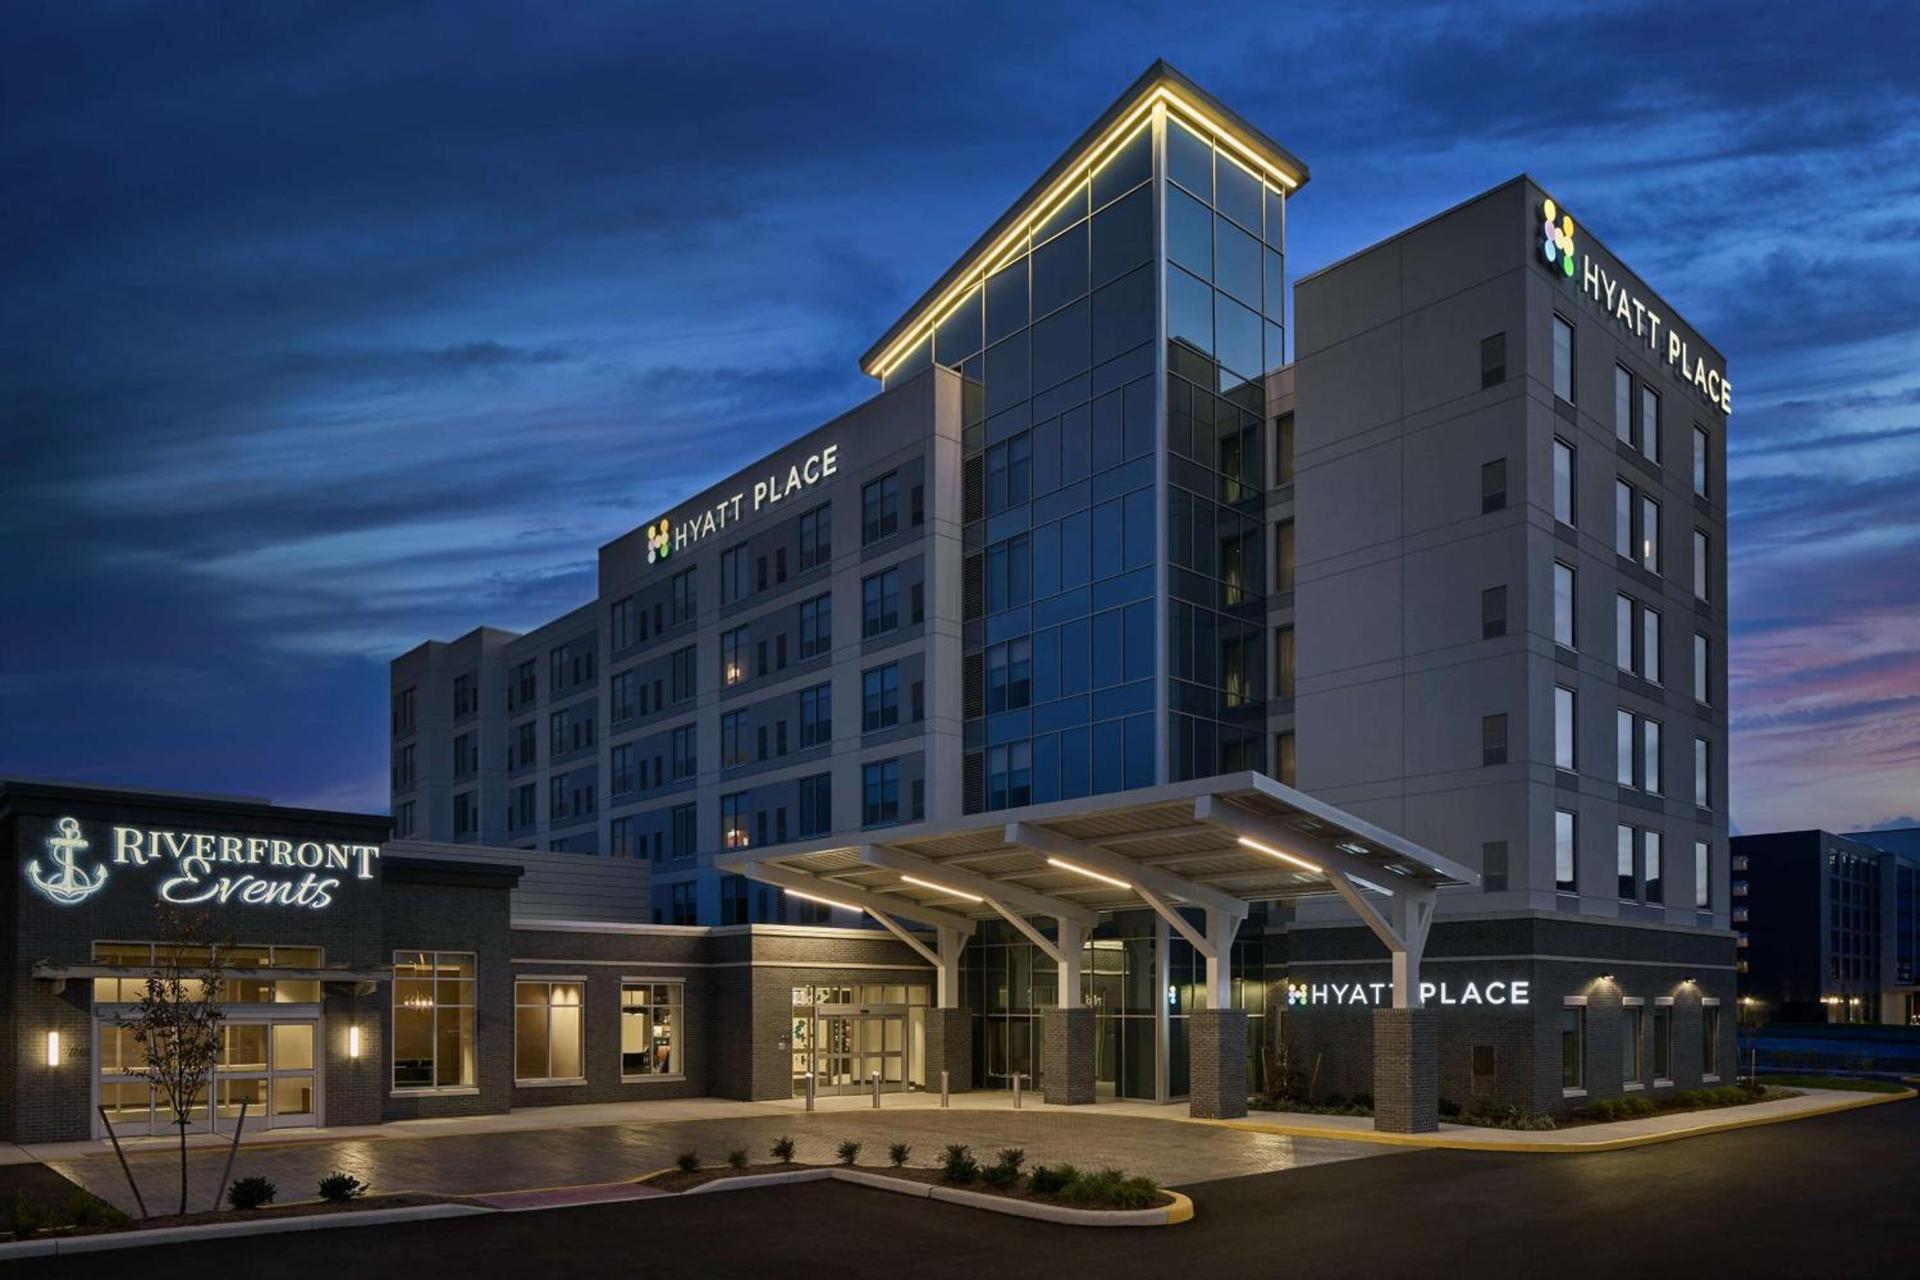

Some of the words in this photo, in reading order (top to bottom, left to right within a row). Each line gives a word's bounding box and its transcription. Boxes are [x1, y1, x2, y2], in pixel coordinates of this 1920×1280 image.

[1583, 254, 1661, 349] HYATT
[1668, 330, 1732, 415] PLACE
[674, 493, 744, 551] HYATT
[754, 444, 838, 510] PLACE
[112, 826, 380, 879] RIVERFRONT
[161, 855, 340, 909] Events
[1311, 983, 1393, 1005] HYAT
[1419, 980, 1530, 1005] PLACE
